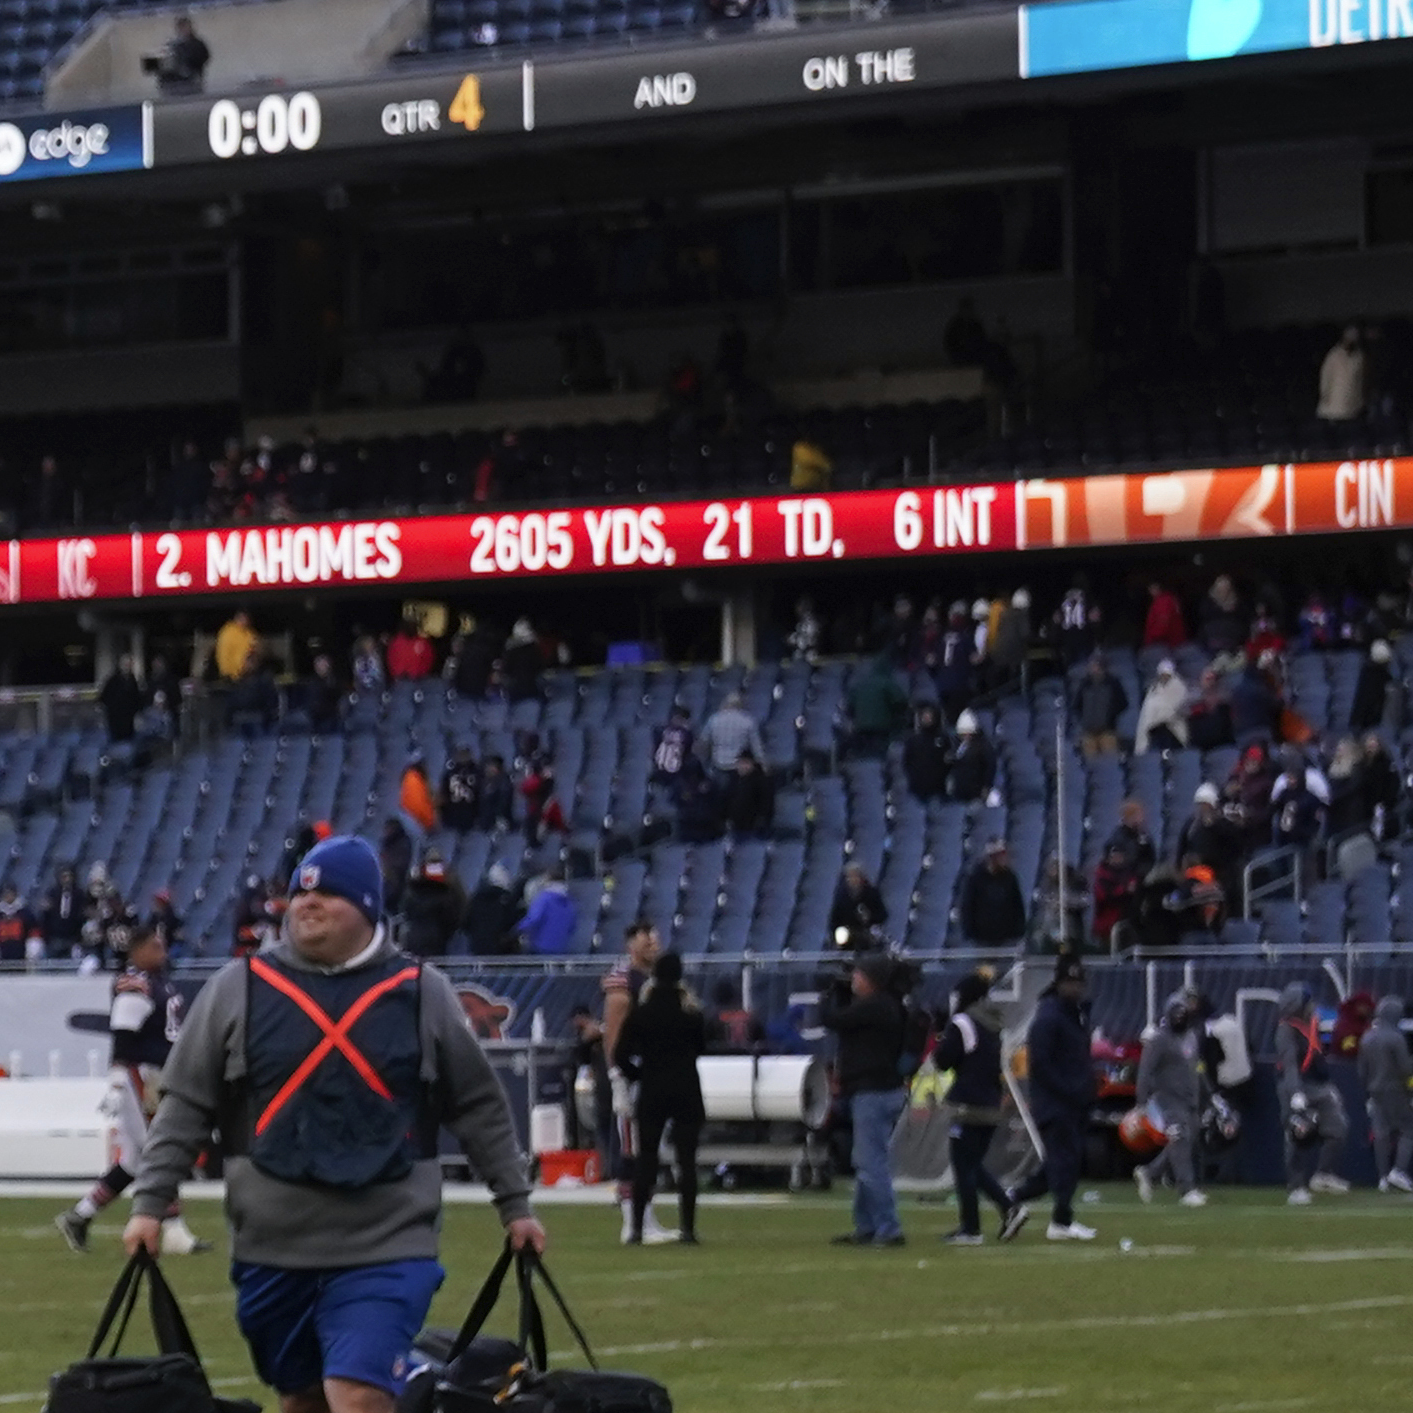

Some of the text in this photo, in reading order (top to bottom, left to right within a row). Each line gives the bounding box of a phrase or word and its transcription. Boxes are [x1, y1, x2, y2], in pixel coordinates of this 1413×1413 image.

[633, 72, 697, 110] AND
[802, 47, 917, 91] ON THE
[207, 90, 322, 158] 0:00
[381, 73, 486, 136] QTR 4
[28, 118, 111, 168] edge
[1334, 458, 1396, 529] CIN
[155, 485, 998, 589] 2. MAHOMES 2605 YDS. 21 TD. 6 INT
